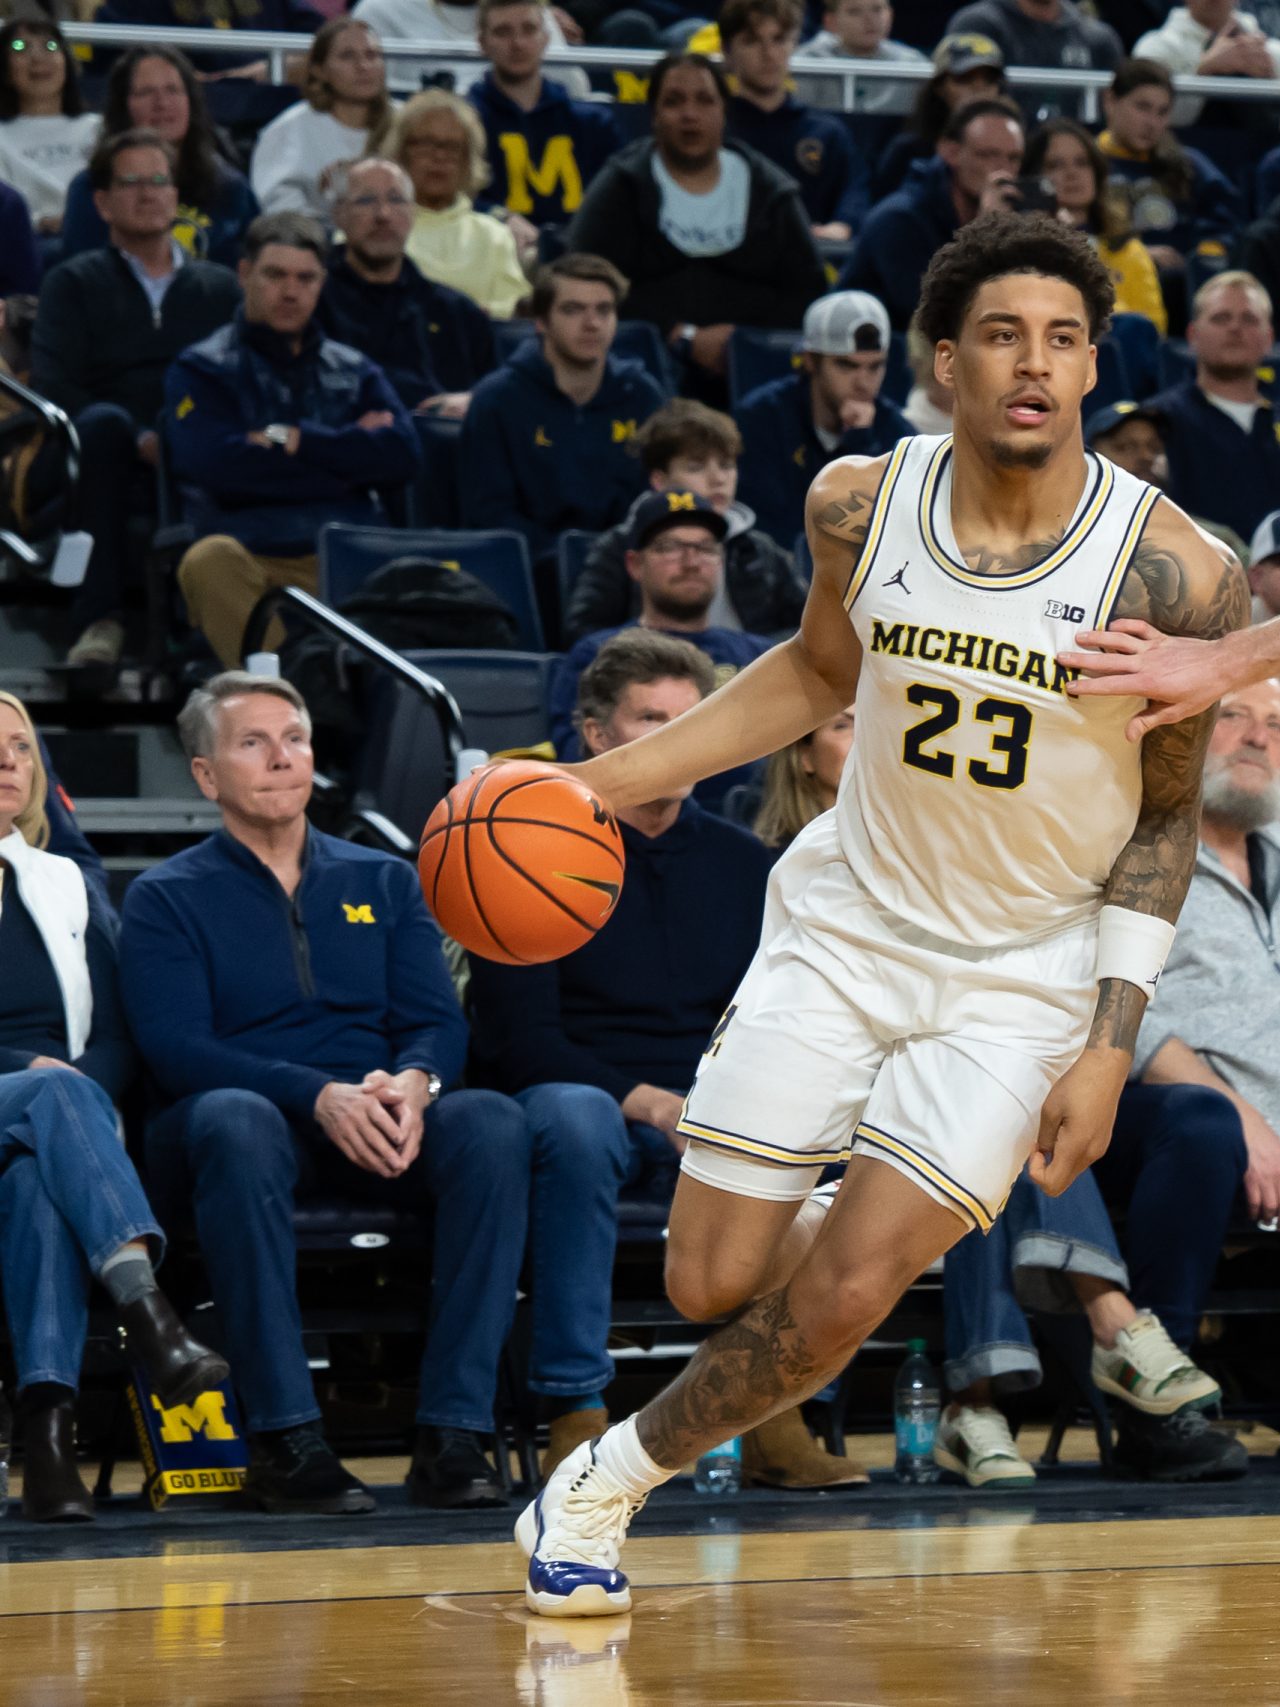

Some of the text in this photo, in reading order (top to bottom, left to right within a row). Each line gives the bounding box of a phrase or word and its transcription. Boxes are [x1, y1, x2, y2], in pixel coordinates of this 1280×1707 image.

[500, 132, 583, 214] M
[667, 492, 695, 511] M
[870, 621, 1082, 699] MICHIGAN
[902, 682, 1034, 791] 23
[342, 903, 376, 924] M
[150, 1390, 236, 1443] M
[170, 1473, 195, 1489] GO
